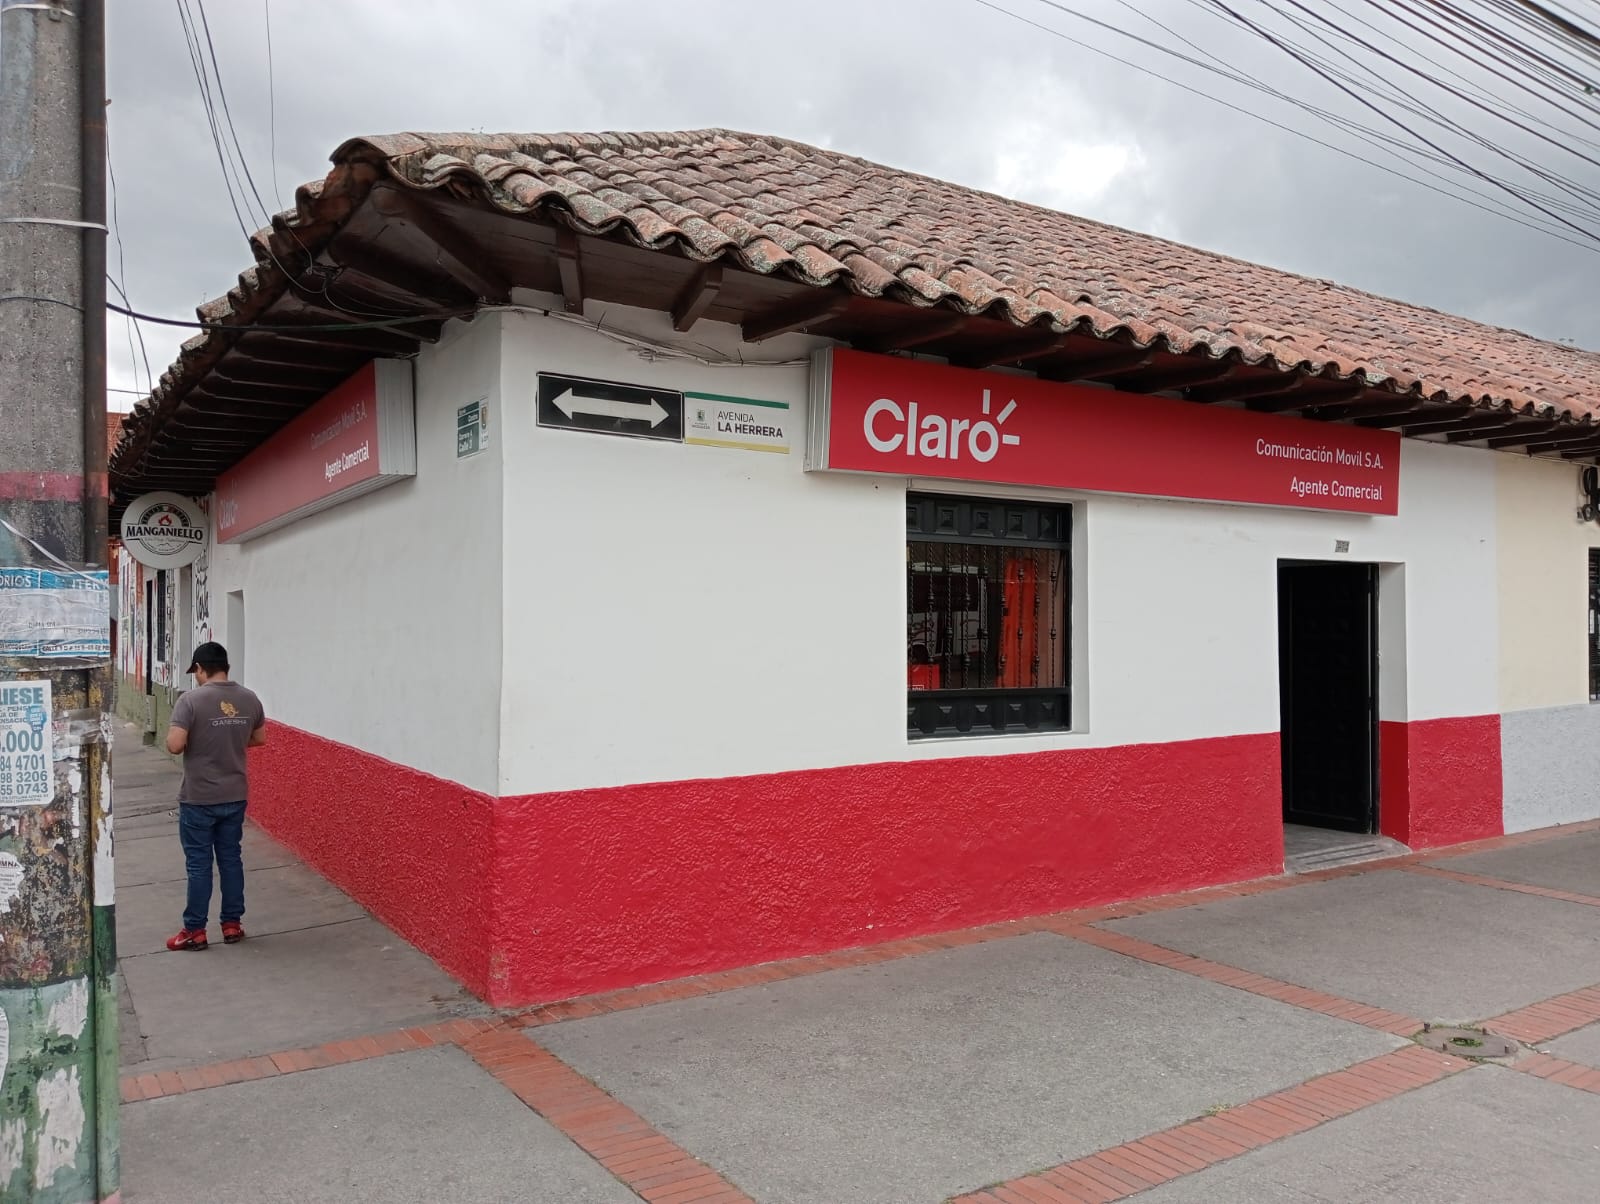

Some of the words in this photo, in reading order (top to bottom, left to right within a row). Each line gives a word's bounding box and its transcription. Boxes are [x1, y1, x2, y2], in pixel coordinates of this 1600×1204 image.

[717, 410, 755, 423] AVENIDA
[717, 421, 733, 433] LA
[734, 423, 784, 438] HERRERA
[864, 398, 999, 463] Claro
[325, 460, 341, 482] Agente
[341, 439, 370, 471] Comercial
[1256, 438, 1333, 464] Comunicación
[1335, 448, 1362, 467] Movil
[1364, 452, 1384, 470] S.A.
[1290, 476, 1329, 498] Agente
[1331, 480, 1383, 500] Comercial
[126, 525, 203, 541] MANGANIELLO
[15, 754, 46, 771] 4701
[16, 771, 48, 783] 3206
[16, 782, 49, 795] 0743
